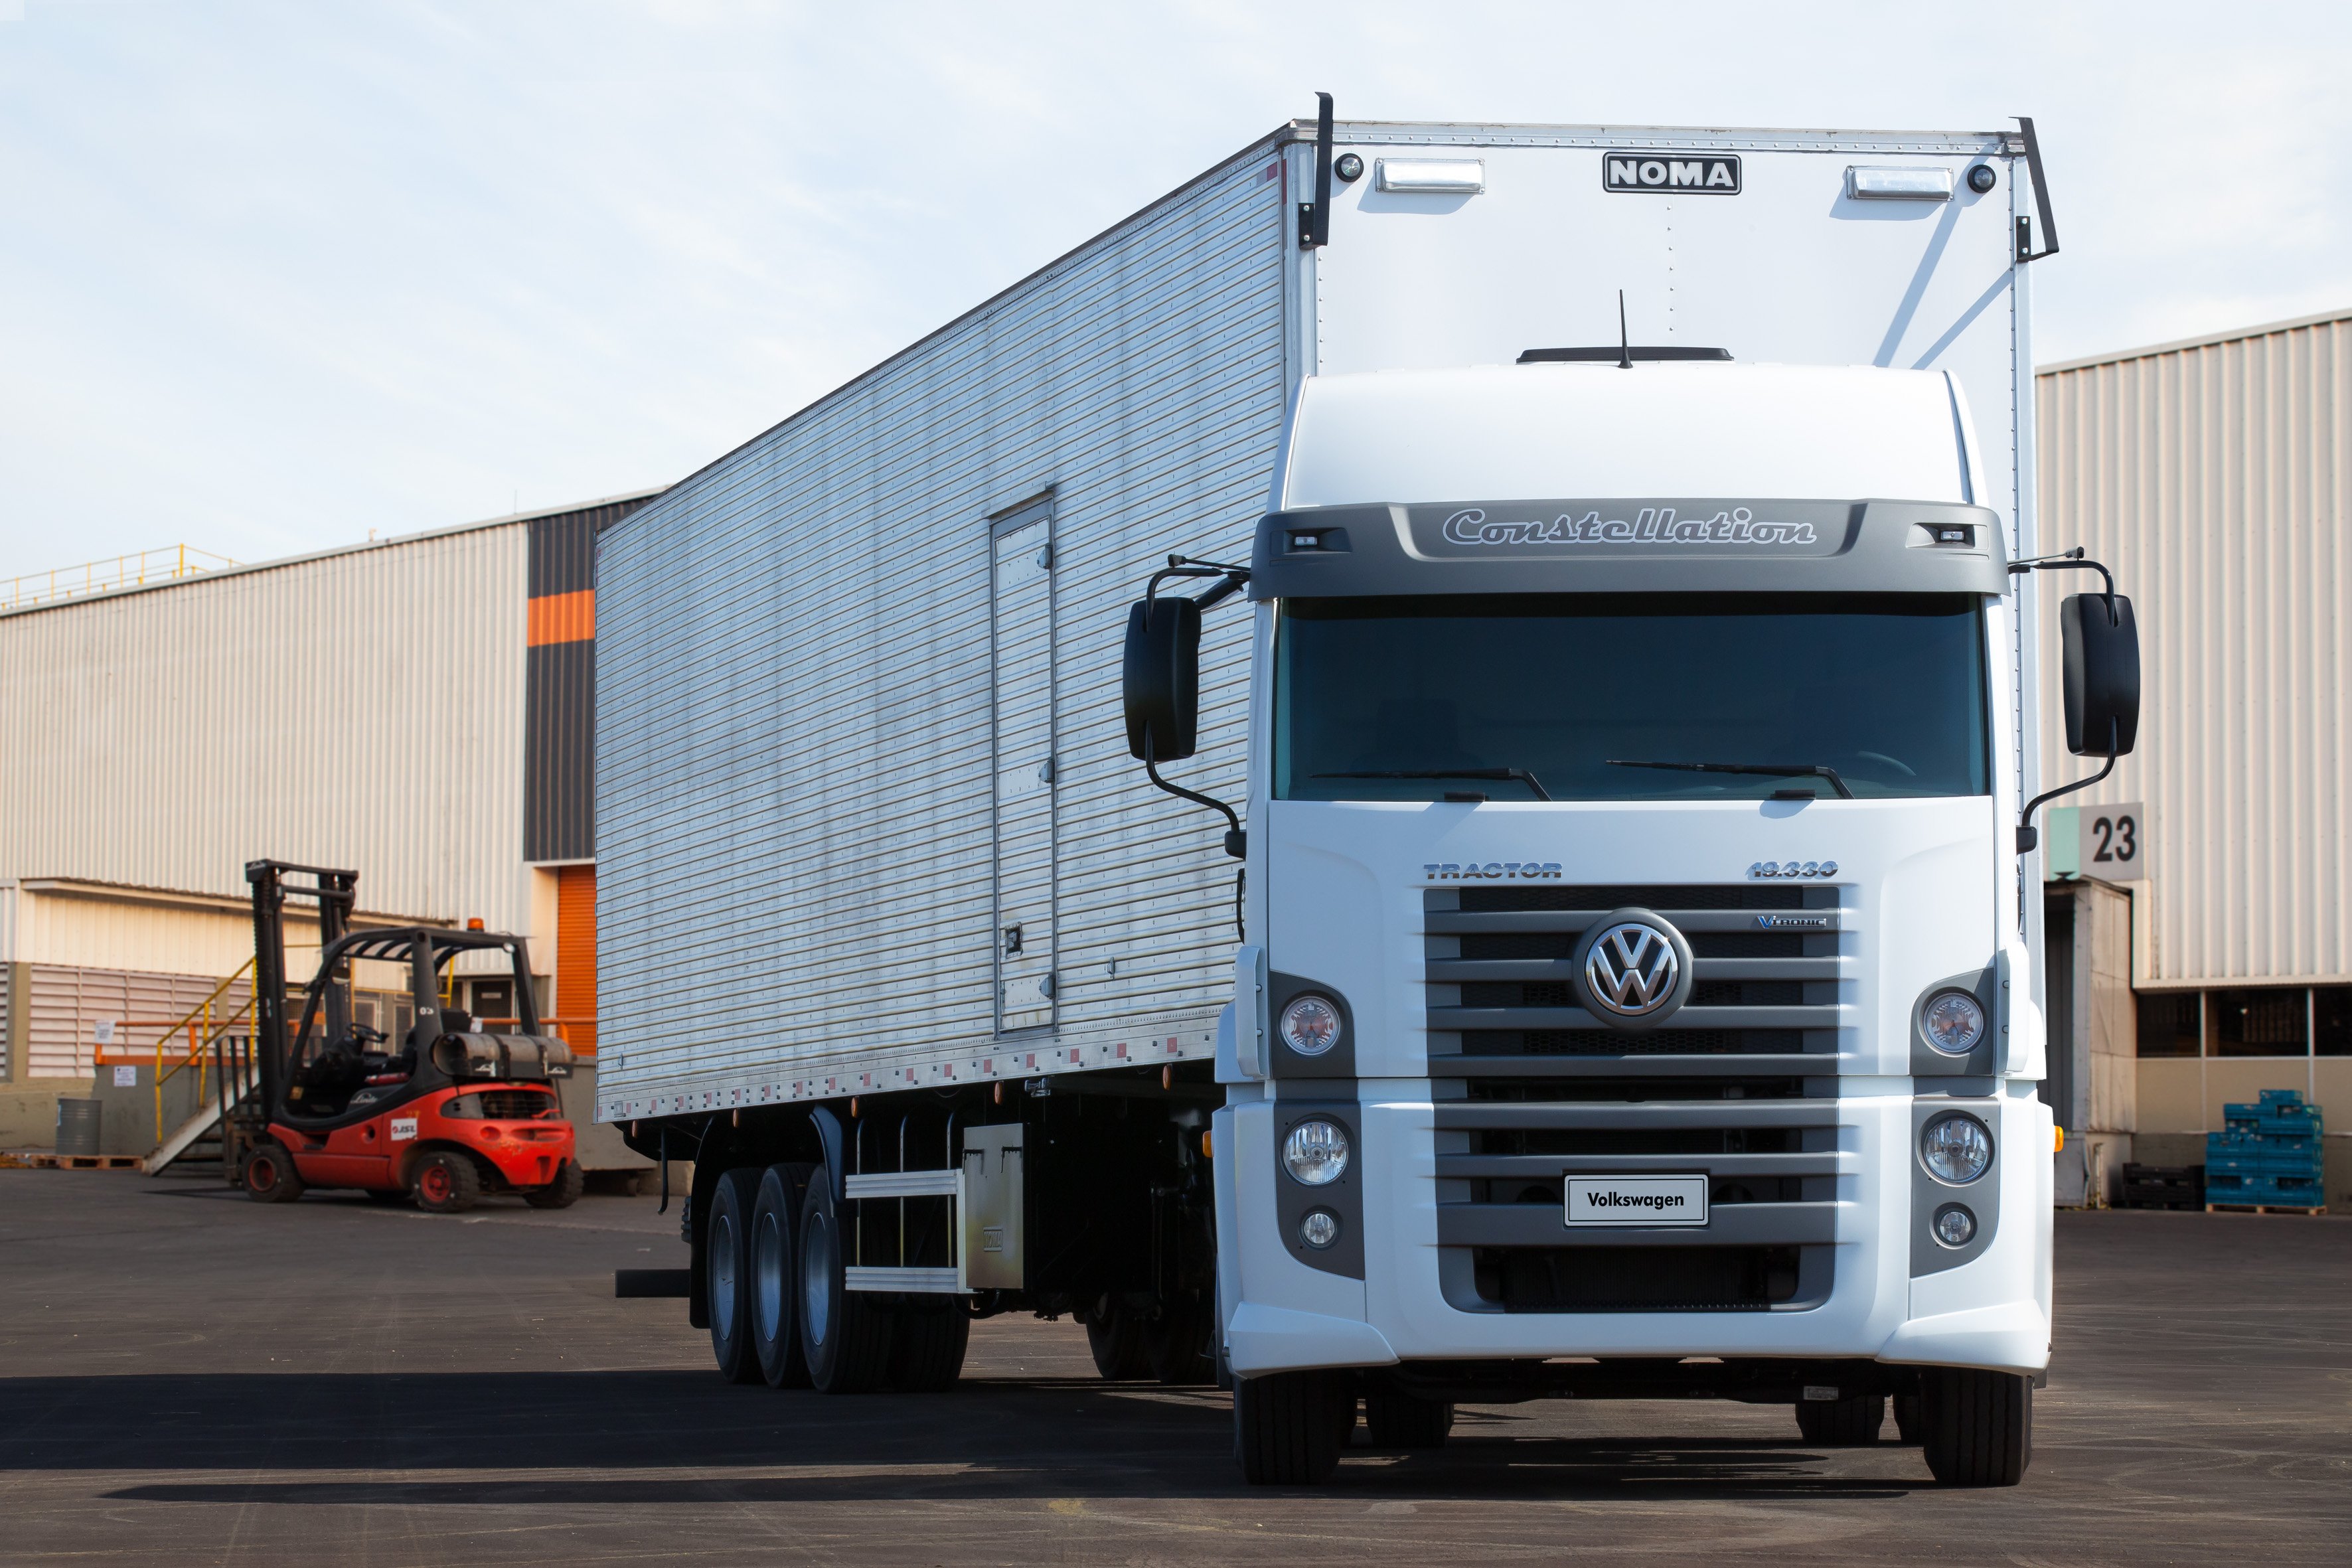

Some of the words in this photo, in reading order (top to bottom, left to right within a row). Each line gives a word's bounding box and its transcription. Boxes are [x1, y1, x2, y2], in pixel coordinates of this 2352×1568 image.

[1610, 160, 1735, 187] NOMA
[1443, 507, 1818, 544] Constellation
[2092, 815, 2136, 862] 23
[1423, 862, 1562, 880] TRACTOR
[1751, 861, 1838, 878] 19.330
[1587, 1192, 1684, 1210] Volkswagen
